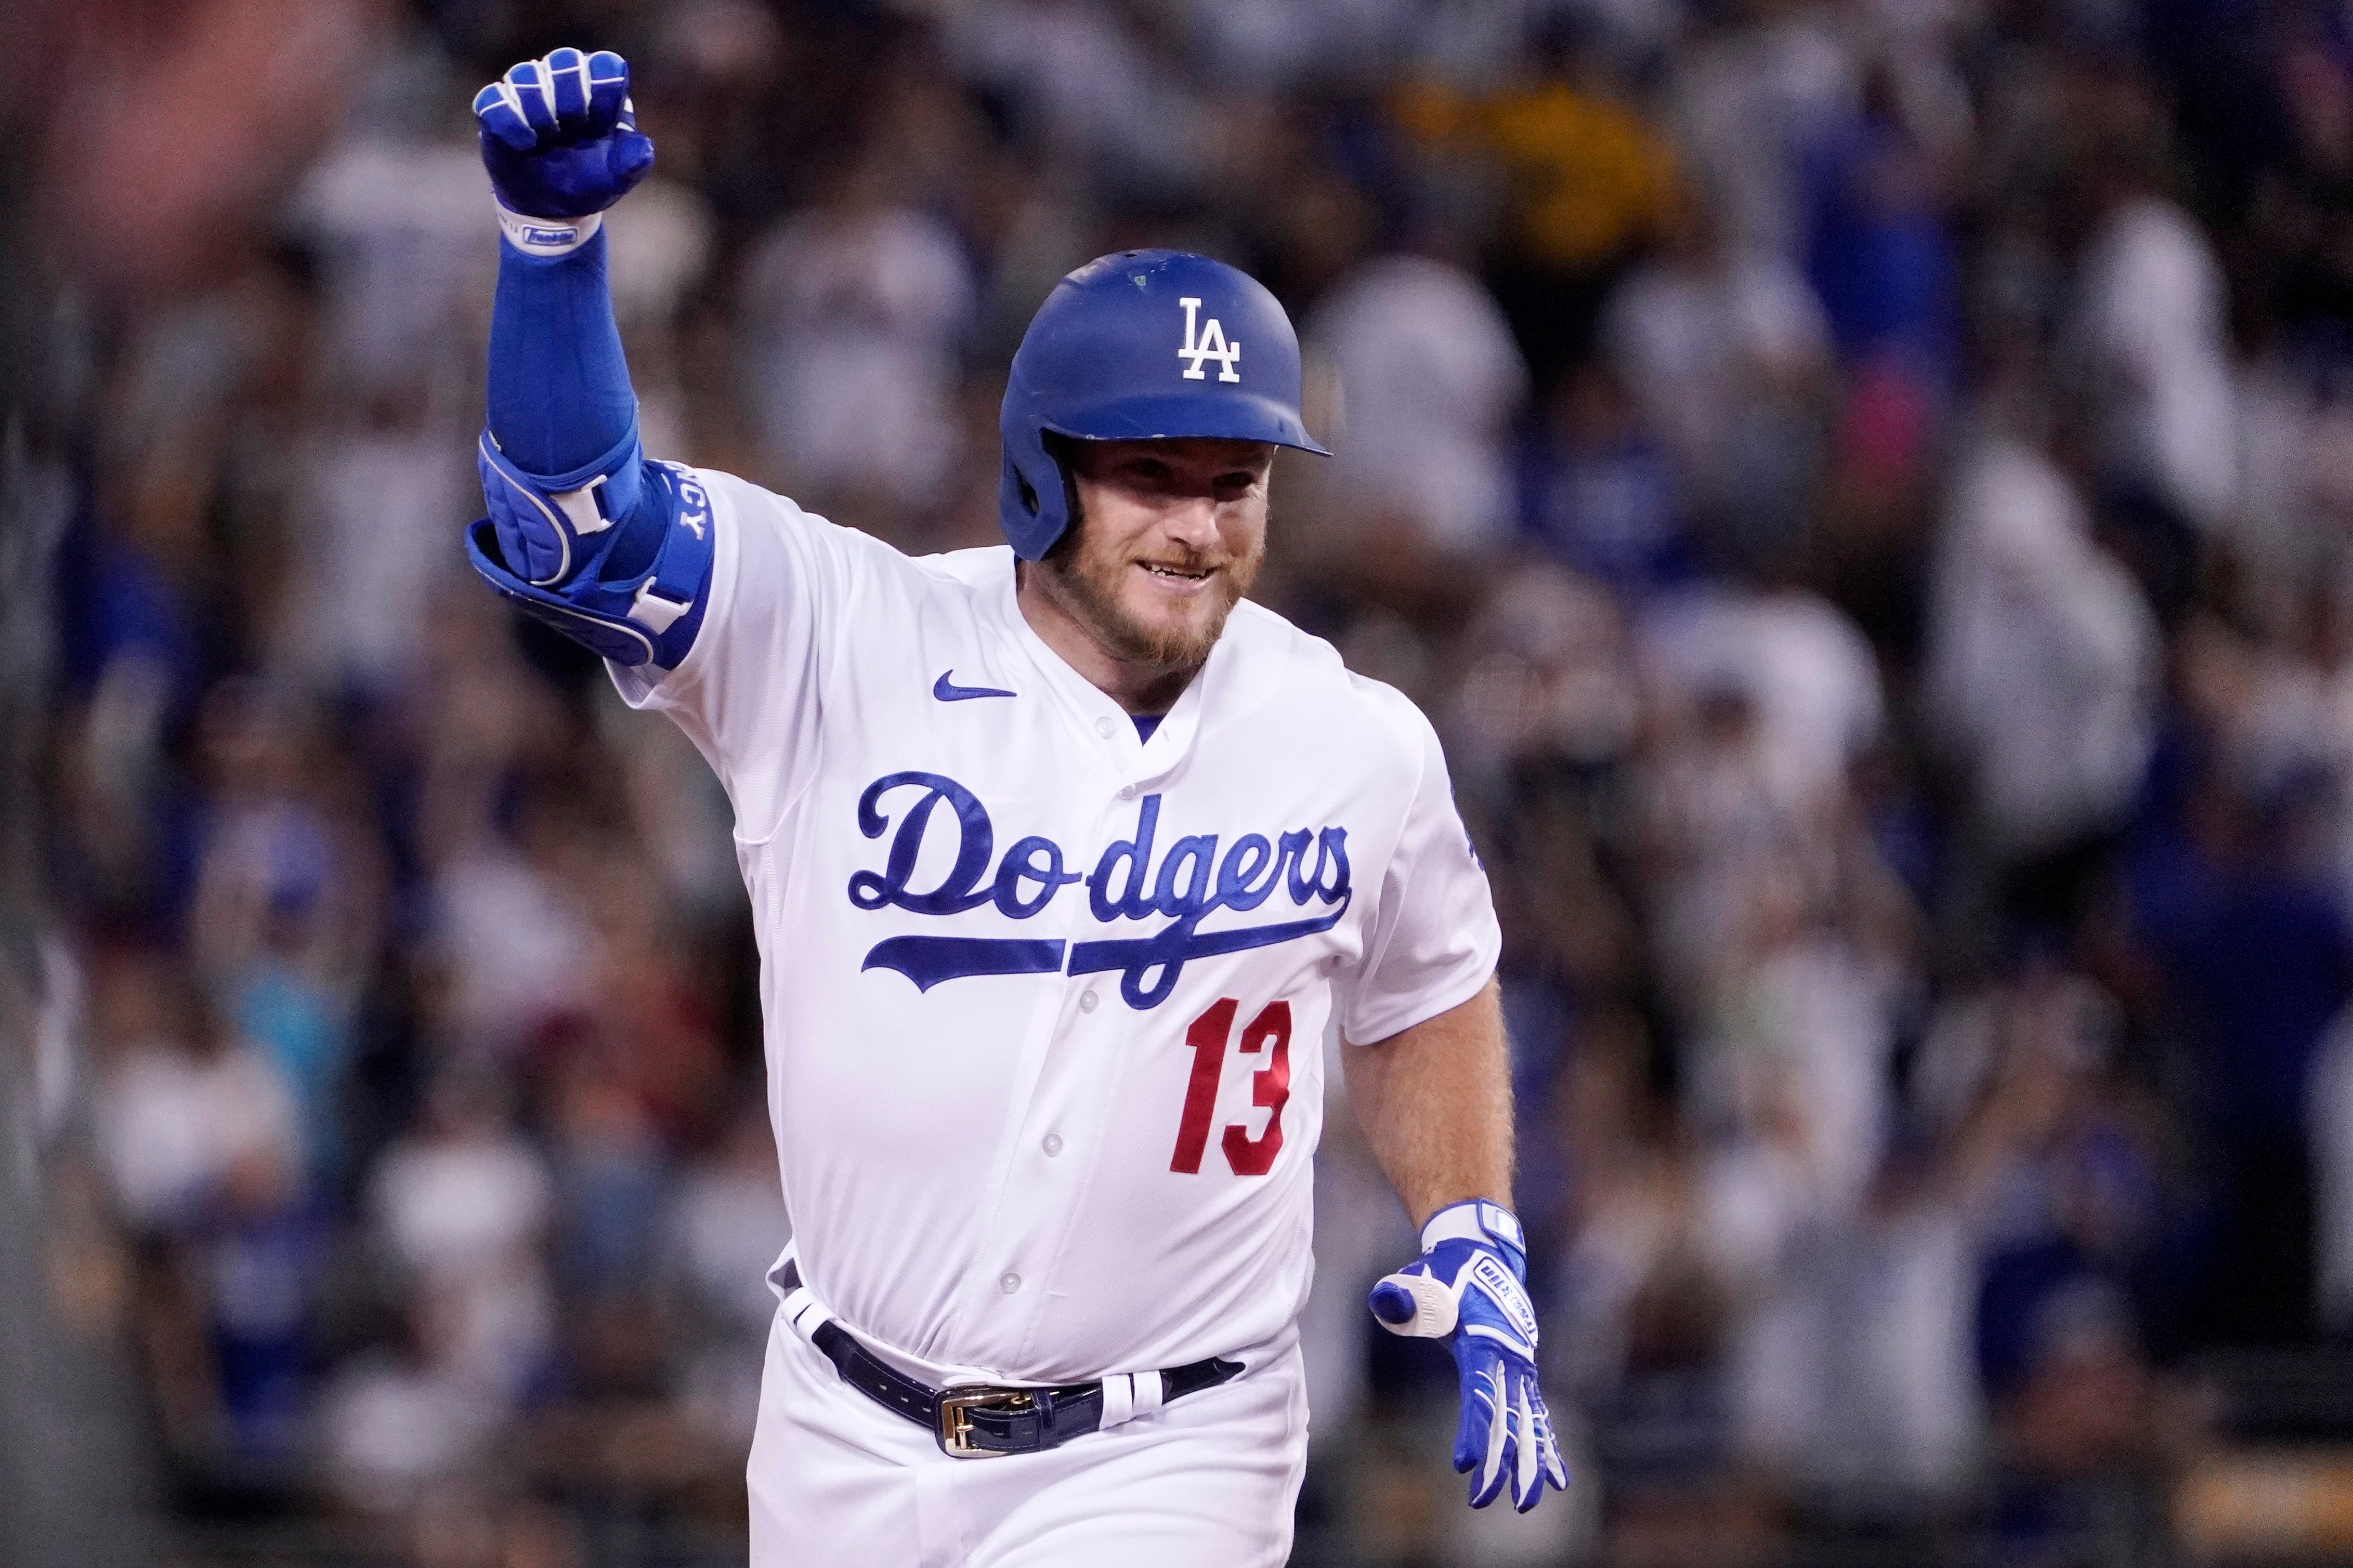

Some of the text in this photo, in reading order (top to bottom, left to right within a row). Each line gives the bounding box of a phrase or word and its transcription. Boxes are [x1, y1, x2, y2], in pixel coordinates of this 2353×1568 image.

[1178, 297, 1240, 383] LA
[664, 462, 708, 541] NCY
[847, 770, 1352, 1010] Dodgers
[1169, 997, 1292, 1176] 13
